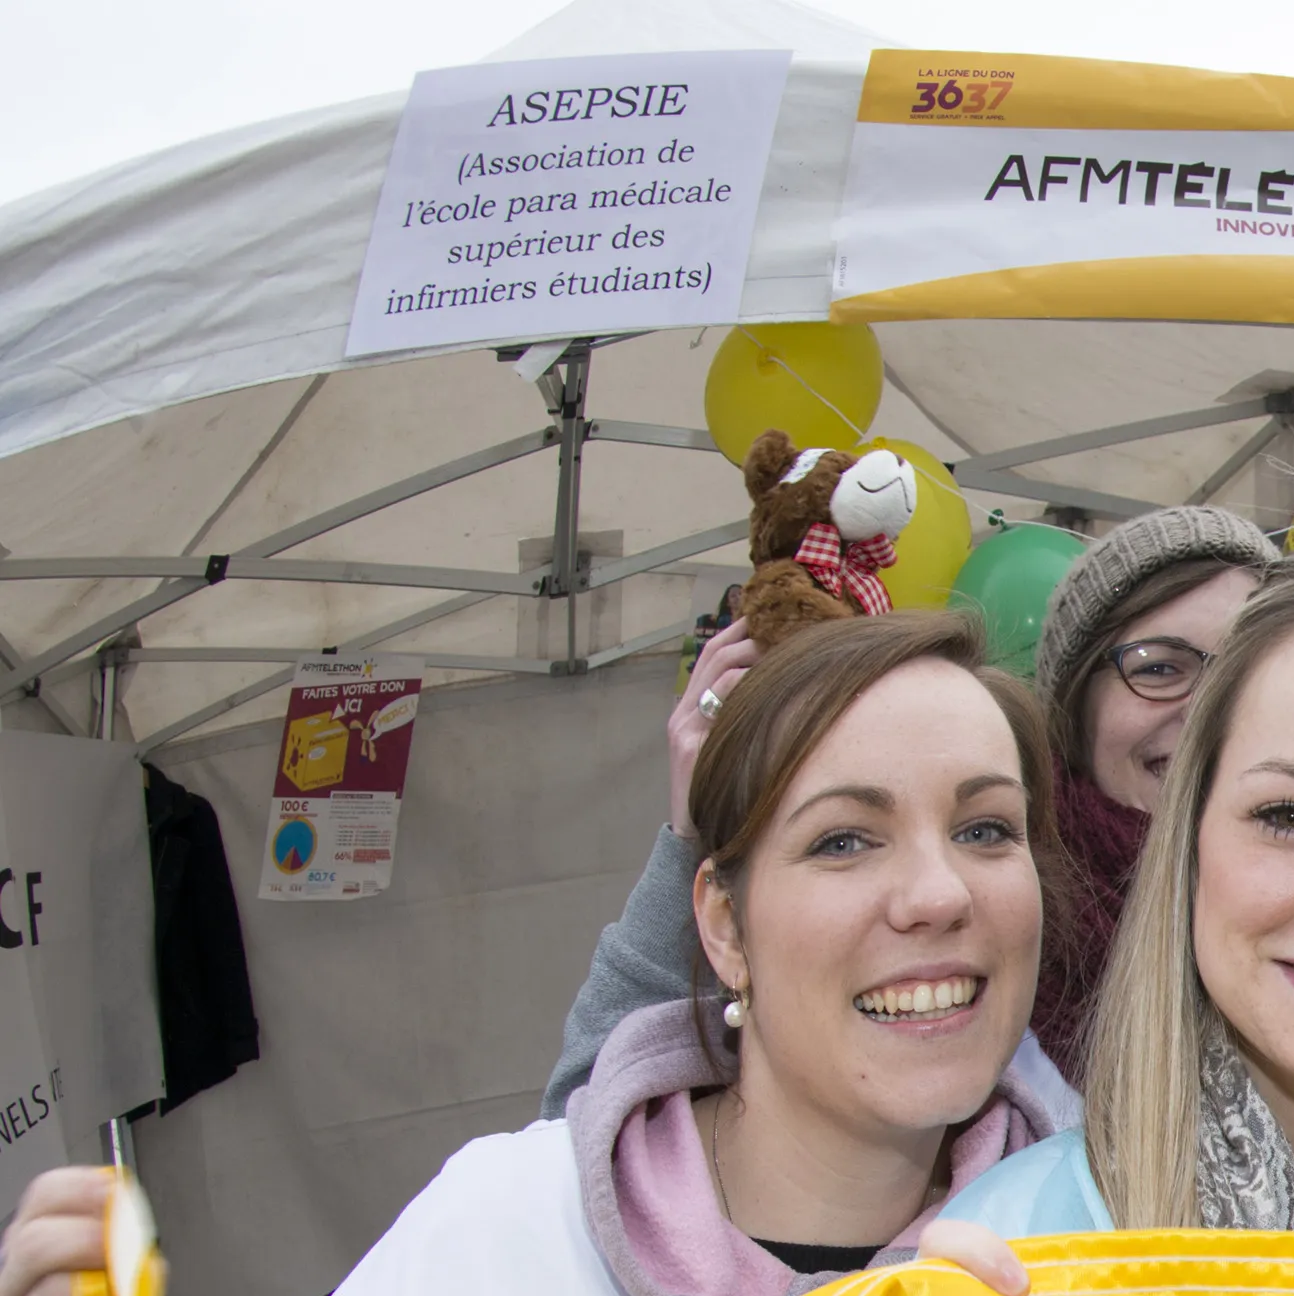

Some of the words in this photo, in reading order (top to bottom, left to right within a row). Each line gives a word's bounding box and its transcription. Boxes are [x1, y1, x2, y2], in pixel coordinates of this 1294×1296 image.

[918, 69, 934, 77] LA
[937, 69, 970, 78] LIGNE
[972, 70, 988, 78] DU
[990, 70, 1015, 79] DON
[486, 84, 688, 127] ASEPSIE
[911, 80, 1013, 113] 3637
[457, 142, 645, 186] (Association
[657, 139, 695, 164] de
[504, 191, 578, 222] para
[588, 177, 732, 210] médicale
[447, 229, 602, 267] supérieur
[611, 223, 666, 249] des
[384, 278, 537, 315] infirmiers
[549, 262, 712, 295] étudiants)
[302, 686, 339, 700] FAITES
[342, 683, 377, 696] VOTRE
[380, 681, 405, 693] DON
[344, 698, 363, 713] ICI
[281, 801, 300, 812] 100
[301, 801, 310, 812] €
